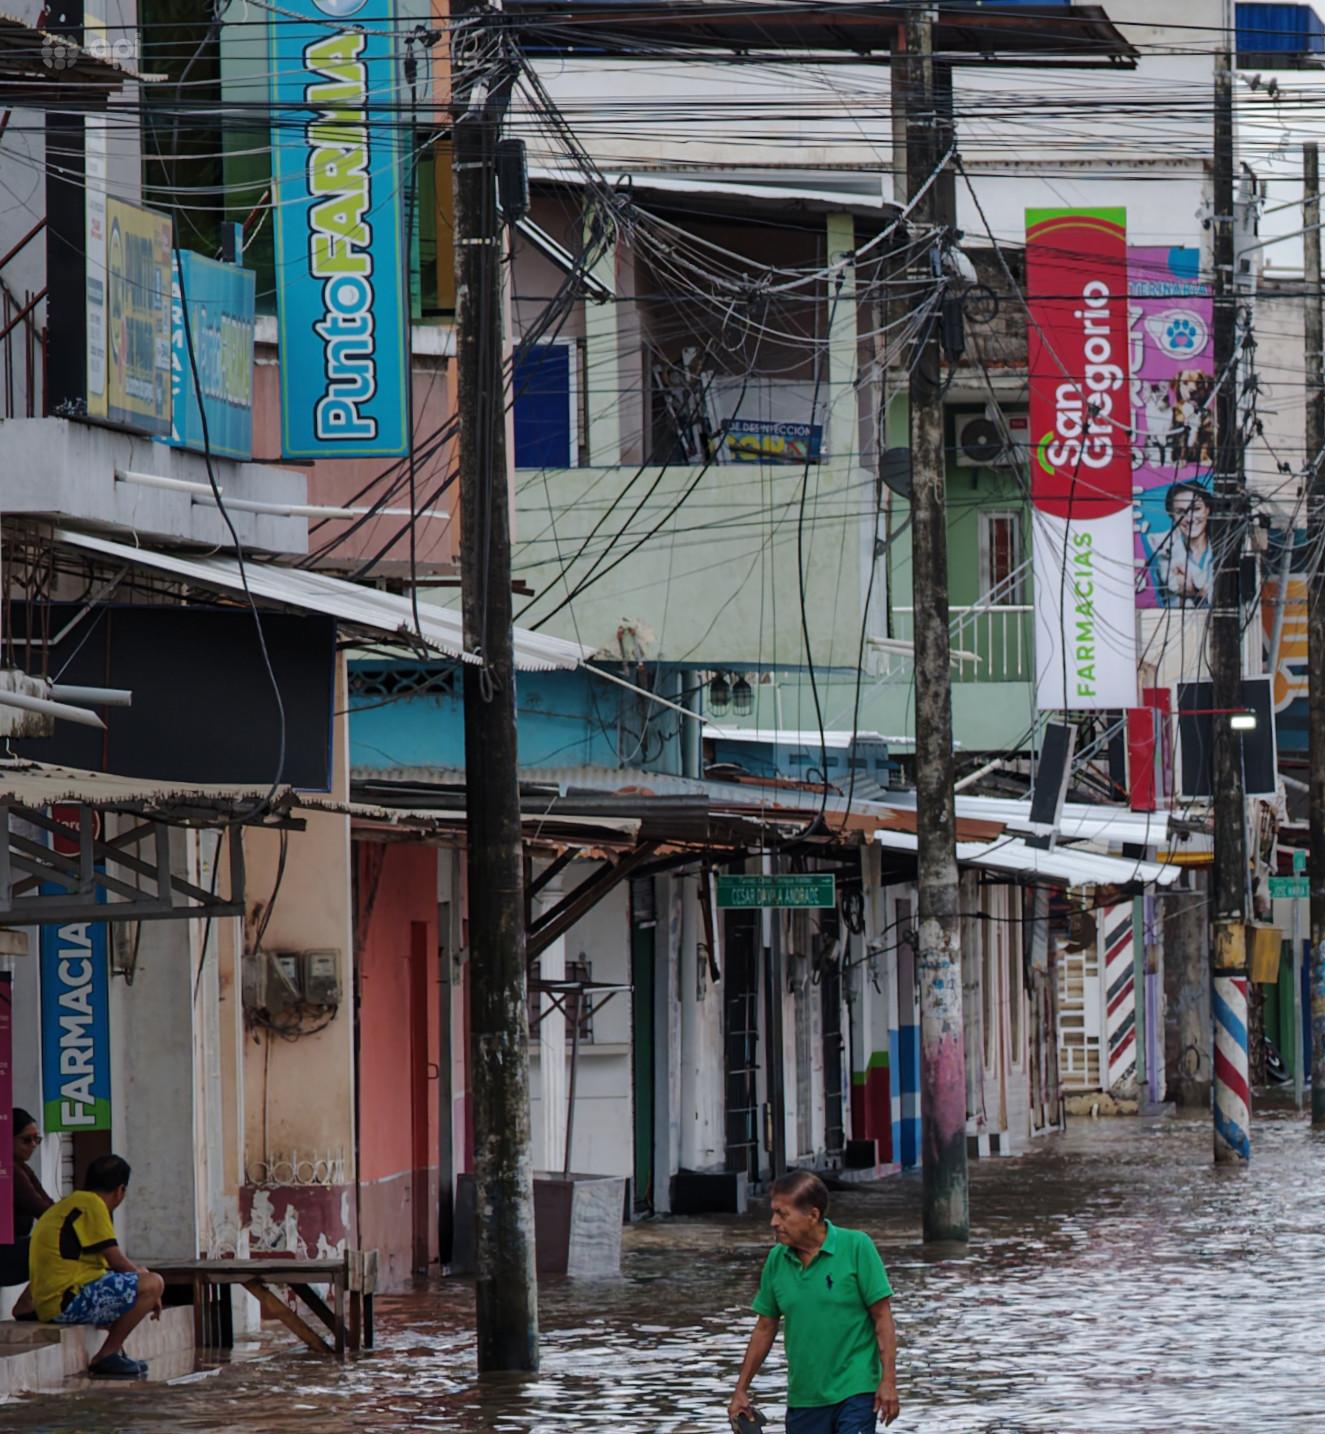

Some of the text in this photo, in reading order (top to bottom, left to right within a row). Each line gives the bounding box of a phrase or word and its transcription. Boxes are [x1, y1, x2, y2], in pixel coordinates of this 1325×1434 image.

[1047, 383, 1082, 467] San
[1074, 280, 1123, 469] Gregorio
[1074, 531, 1095, 698] FARMACIAS
[58, 921, 96, 1127] FARMACIA
